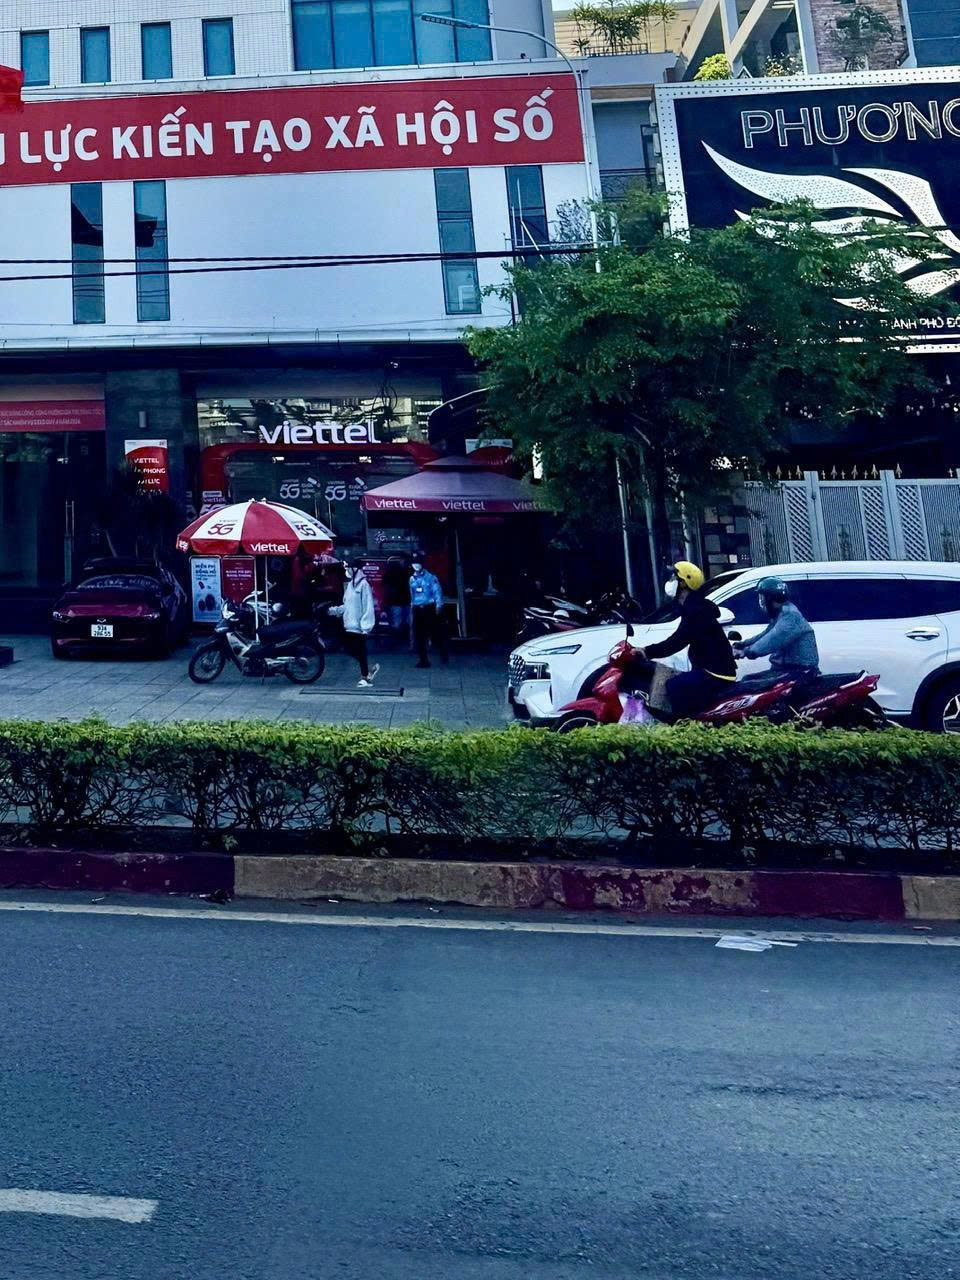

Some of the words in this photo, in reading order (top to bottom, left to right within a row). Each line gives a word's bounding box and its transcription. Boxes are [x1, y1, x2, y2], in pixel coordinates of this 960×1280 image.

[20, 122, 99, 172] LỰC
[112, 106, 214, 159] KIẾN
[225, 117, 311, 162] TẠO
[324, 105, 384, 148] XÃ
[397, 99, 478, 155] HỘI
[493, 87, 555, 144] SỐ
[259, 420, 381, 444] viettel
[280, 483, 300, 499] 5G
[324, 485, 347, 501] 5G
[374, 499, 417, 509] viettel
[442, 500, 486, 510] viettel
[207, 523, 236, 535] 5G
[250, 543, 290, 553] viettel
